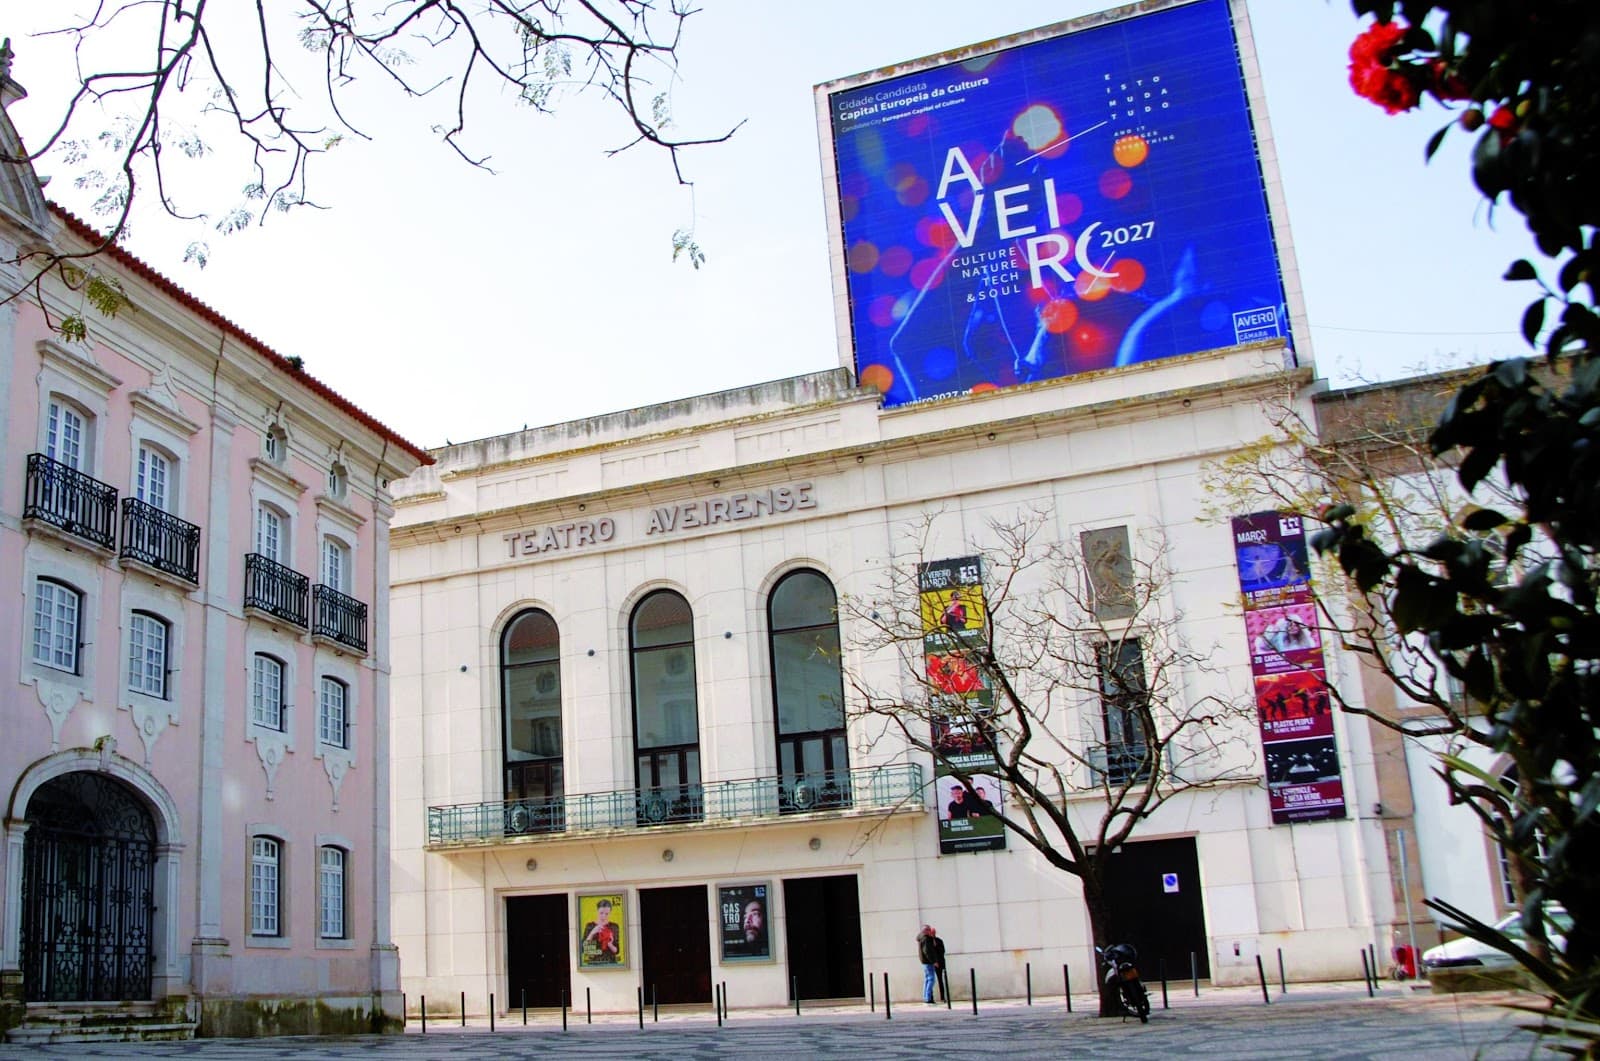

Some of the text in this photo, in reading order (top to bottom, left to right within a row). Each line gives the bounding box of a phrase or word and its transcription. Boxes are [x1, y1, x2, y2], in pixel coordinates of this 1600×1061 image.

[1106, 76, 1160, 94] ISTO
[838, 81, 927, 111] Cidade Candidata
[840, 77, 990, 121] Capital Europeia da Cultura
[1109, 88, 1168, 107] MUDA
[882, 110, 912, 123] European
[912, 104, 934, 116] Capital
[942, 97, 966, 109] Culture
[1111, 102, 1169, 120] TUDO
[1100, 221, 1155, 249] 2027
[952, 246, 1017, 268] CULTURE
[962, 260, 1018, 279] NATURE
[983, 272, 1019, 288] TECH
[502, 482, 817, 558] TEATRO AVEIRENSE
[1294, 717, 1314, 726] PEOPLE
[723, 903, 740, 914] CAS
[723, 913, 740, 924] TRO
